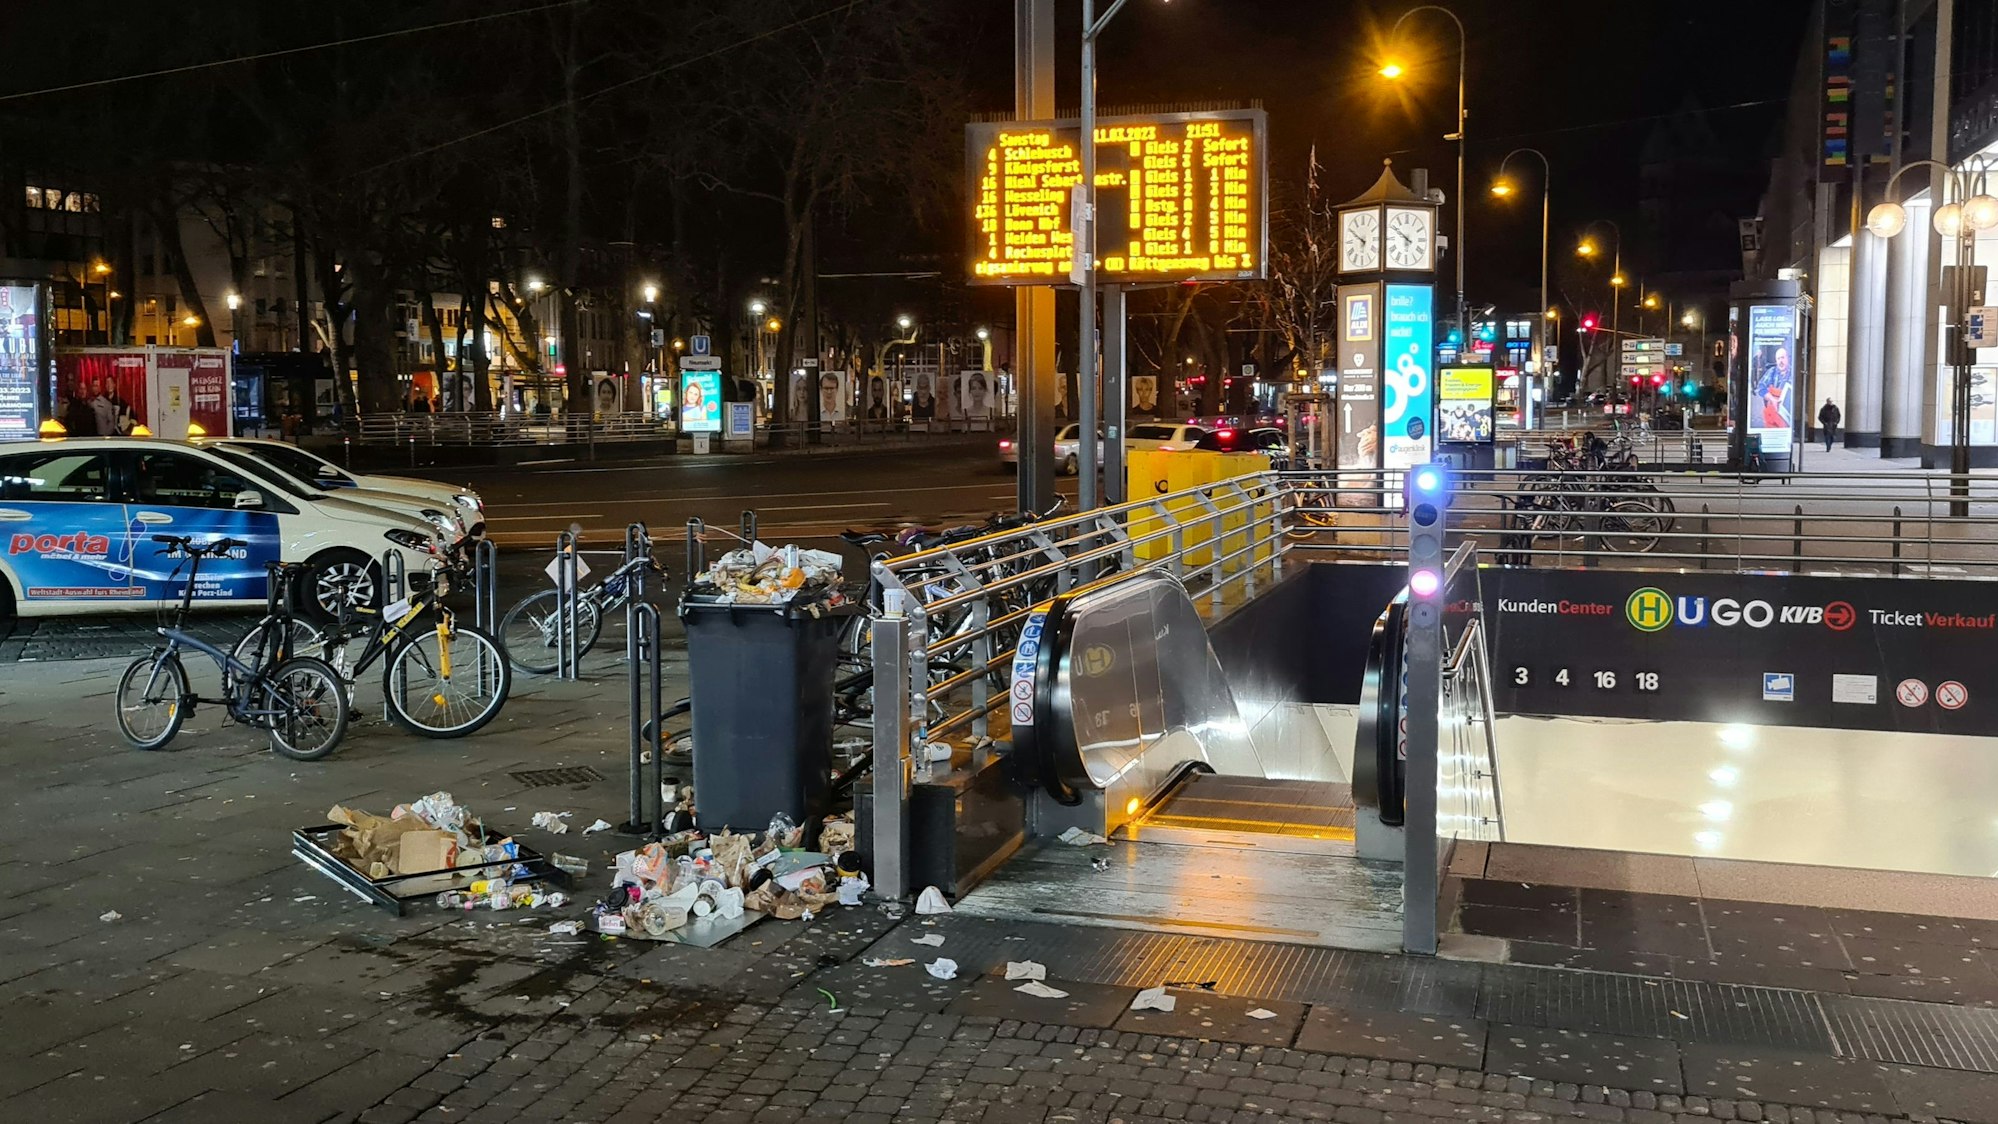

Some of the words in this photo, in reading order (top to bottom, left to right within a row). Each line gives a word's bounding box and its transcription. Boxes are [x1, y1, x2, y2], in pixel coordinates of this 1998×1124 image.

[1000, 134, 1049, 147] Samstag
[1094, 127, 1156, 143] 11.03.2023
[1187, 124, 1220, 138] 21:51
[988, 148, 997, 161] 4
[1005, 145, 1072, 161] Schlebusch
[1146, 141, 1179, 154] Gleis
[1184, 140, 1193, 153] 2
[1203, 138, 1248, 152] Sofort
[988, 162, 997, 175] 9
[1005, 160, 1079, 175] Königsforst
[1144, 155, 1177, 169] Gleis
[1182, 154, 1191, 168] 3
[1203, 152, 1248, 167] Sofort
[982, 177, 997, 190] 16
[1145, 170, 1179, 183] Gleis
[1184, 169, 1193, 182] 1
[1210, 168, 1219, 181] 1
[1224, 167, 1247, 180] Min
[982, 191, 997, 204] 16
[1005, 189, 1064, 203] Wesseling
[1146, 184, 1179, 198] Gleis
[1184, 183, 1193, 197] 2
[1210, 182, 1219, 196] 3
[1224, 181, 1247, 195] Min
[976, 205, 997, 218] 136
[1005, 202, 1059, 217] Lövenich
[1210, 197, 1219, 210] 4
[1224, 195, 1247, 209] Min
[982, 219, 997, 232] 18
[1005, 218, 1034, 231] Bonn
[1038, 217, 1060, 230] Hbf
[1145, 212, 1179, 227] Gleis
[1184, 212, 1193, 226] 2
[1210, 211, 1219, 225] 5
[1224, 210, 1247, 224] Min
[989, 233, 997, 245] 1
[1005, 231, 1046, 245] Weiden
[1144, 227, 1176, 241] Gleis
[1182, 226, 1191, 240] 4
[1210, 225, 1219, 239] 5
[1224, 224, 1247, 238] Min
[989, 246, 997, 259] 4
[1145, 241, 1179, 255] Gleis
[1184, 240, 1192, 254] 1
[1224, 239, 1247, 253] Min
[1214, 255, 1237, 268] bis
[1351, 321, 1368, 330] ALDI
[695, 338, 706, 353] U
[9, 532, 109, 554] porta
[1638, 595, 1661, 623] H
[1779, 606, 1824, 625] KVB
[1515, 668, 1529, 686] 3
[1555, 668, 1570, 686] 4
[1594, 670, 1616, 689] 16
[1635, 672, 1660, 691] 18
